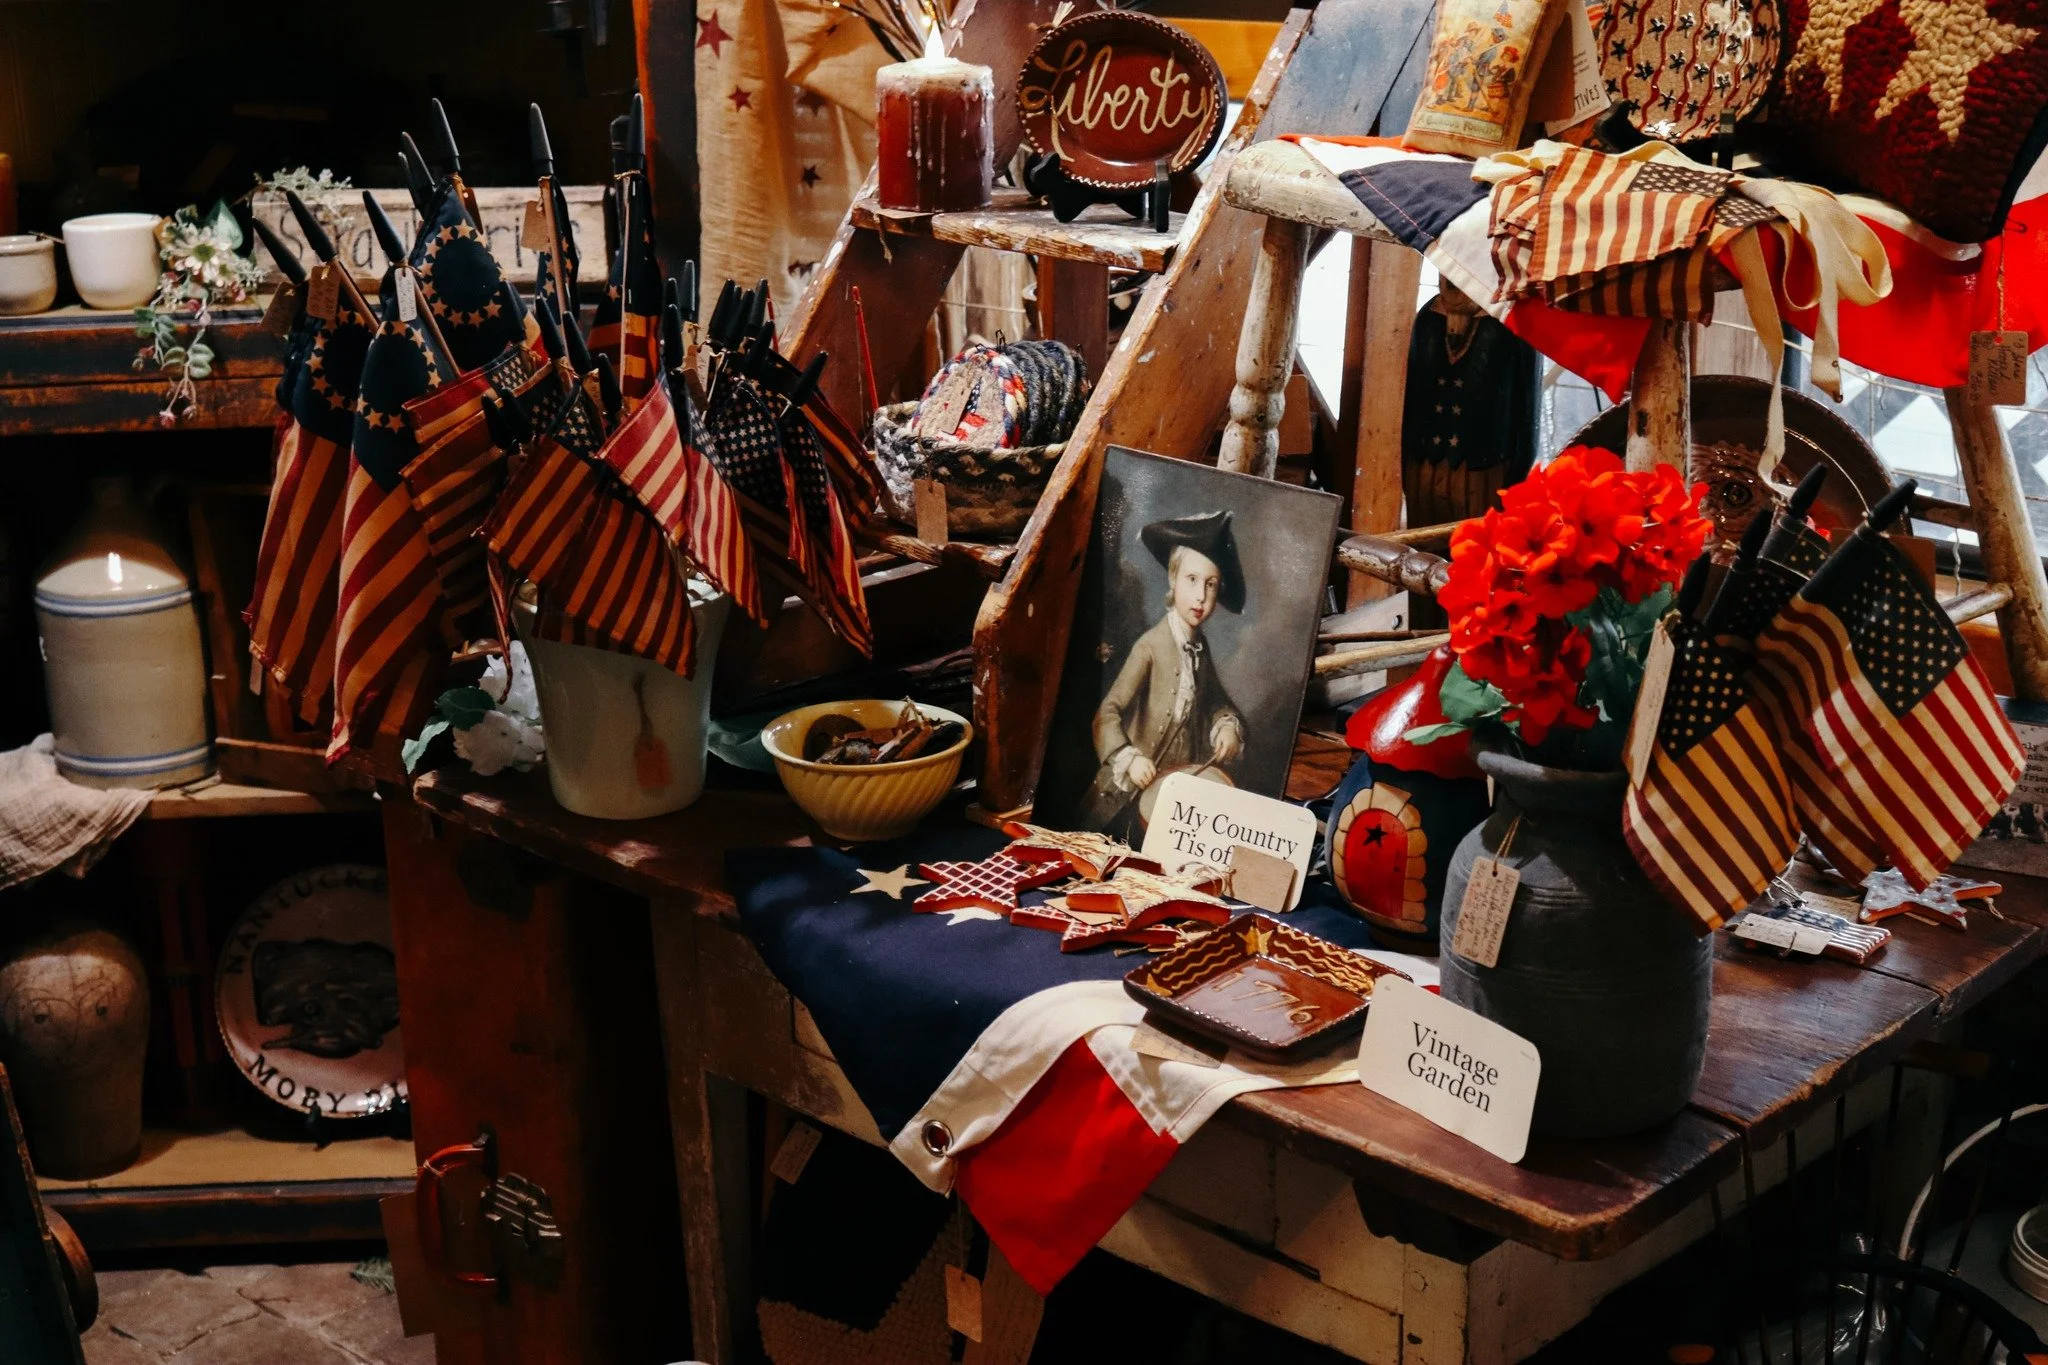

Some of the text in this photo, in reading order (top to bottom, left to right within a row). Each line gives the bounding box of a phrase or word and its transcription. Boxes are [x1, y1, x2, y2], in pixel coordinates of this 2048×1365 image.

[1020, 39, 1214, 167] Liberty
[1170, 801, 1299, 860] My Country
[1210, 845, 1235, 866] of
[225, 869, 388, 974] NANTUCKE
[1212, 971, 1321, 1024] 1776
[249, 1054, 346, 1113] MOBY
[1407, 1051, 1492, 1114] Garden
[1412, 1021, 1499, 1087] Vintage
